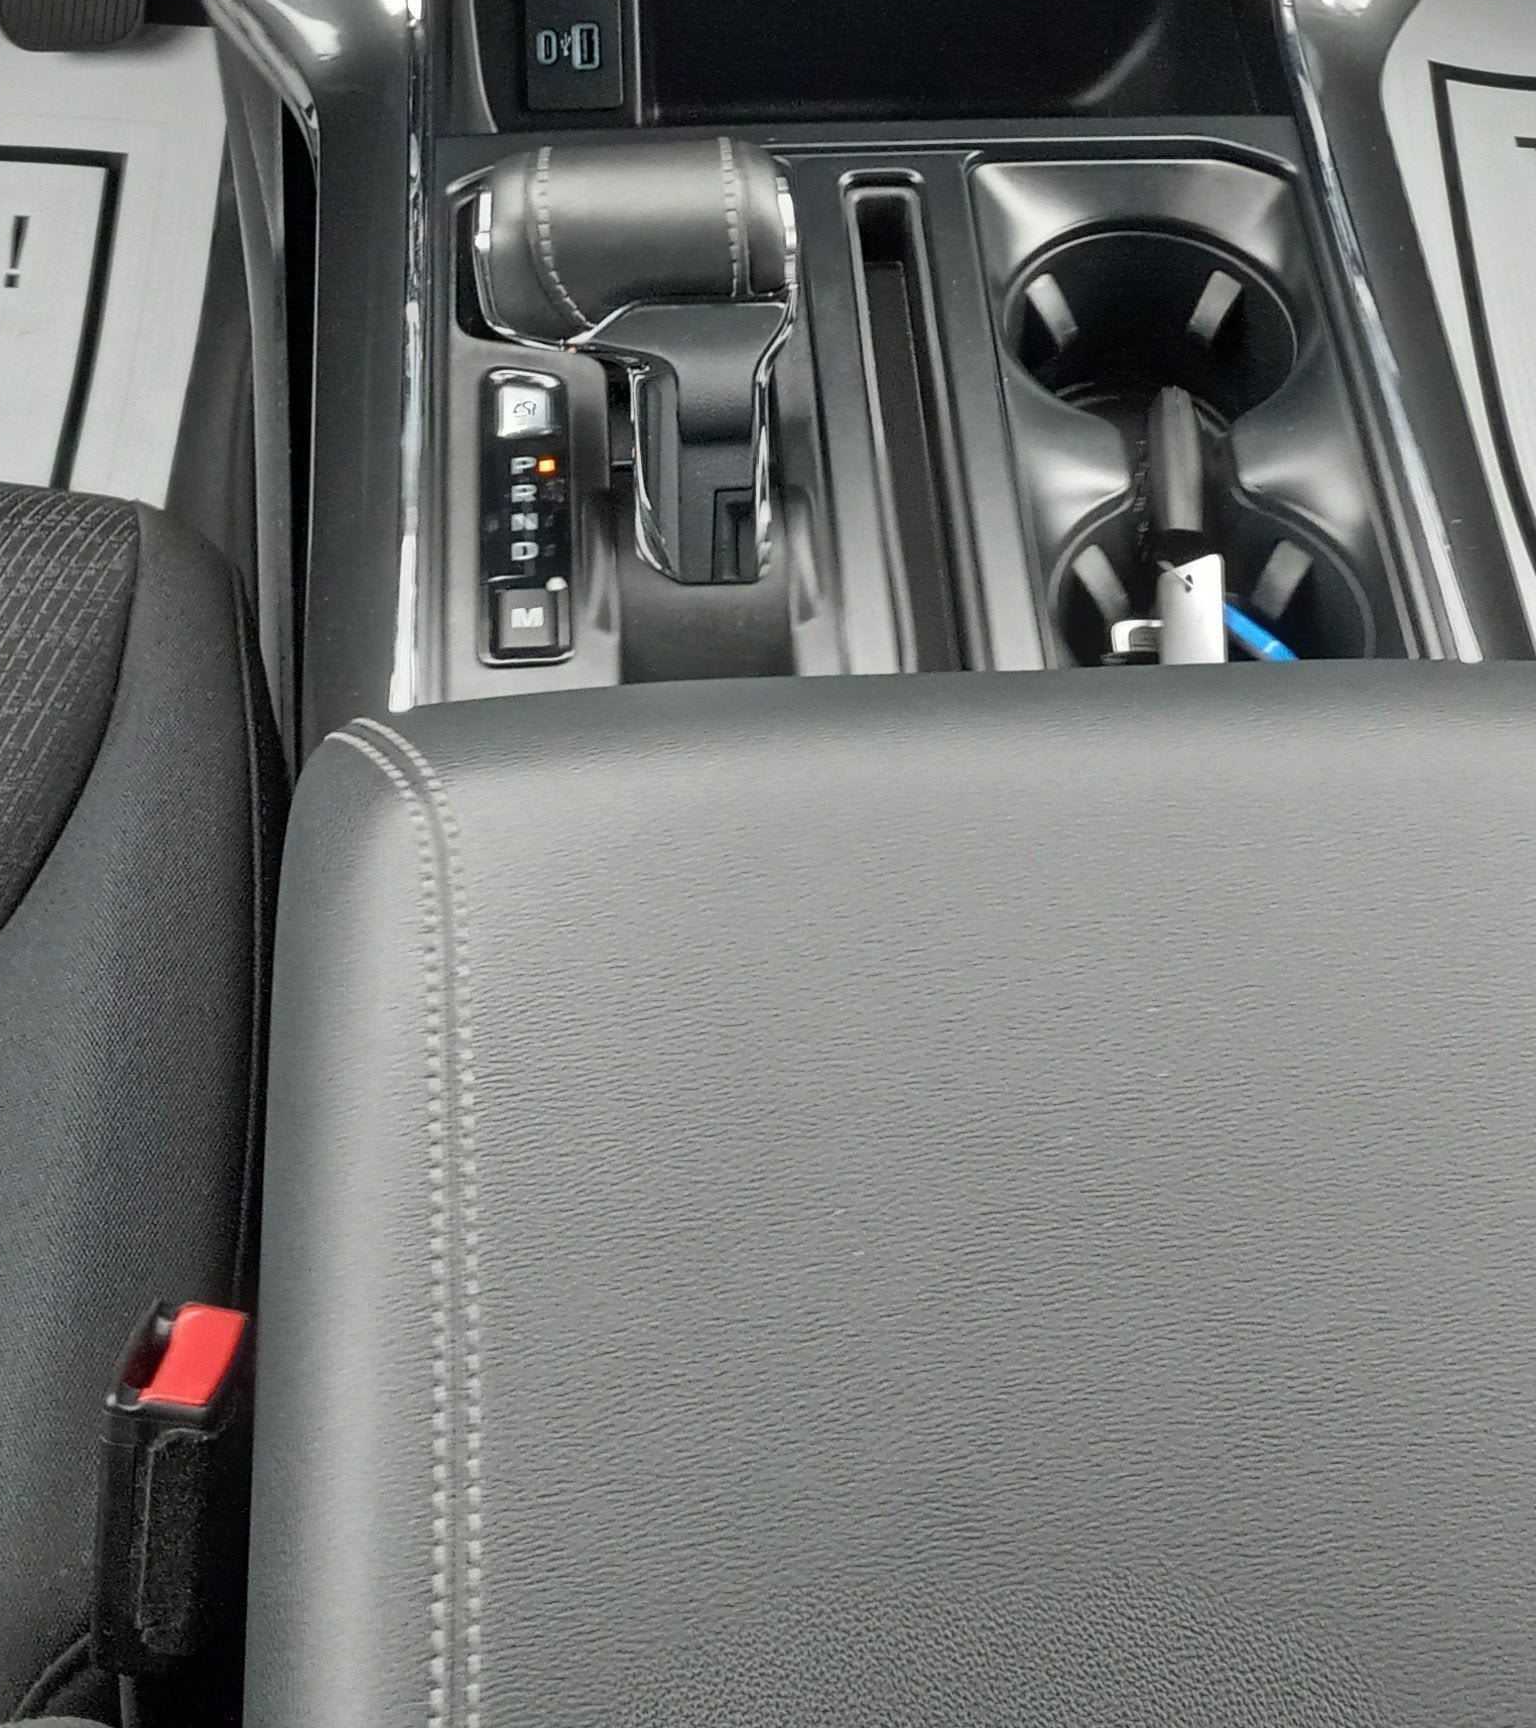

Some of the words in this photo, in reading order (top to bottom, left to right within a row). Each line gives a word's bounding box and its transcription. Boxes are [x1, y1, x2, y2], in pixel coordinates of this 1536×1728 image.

[511, 456, 537, 475] P
[511, 485, 538, 503] R
[511, 512, 539, 532] N
[511, 541, 539, 561] D
[511, 607, 545, 629] M
